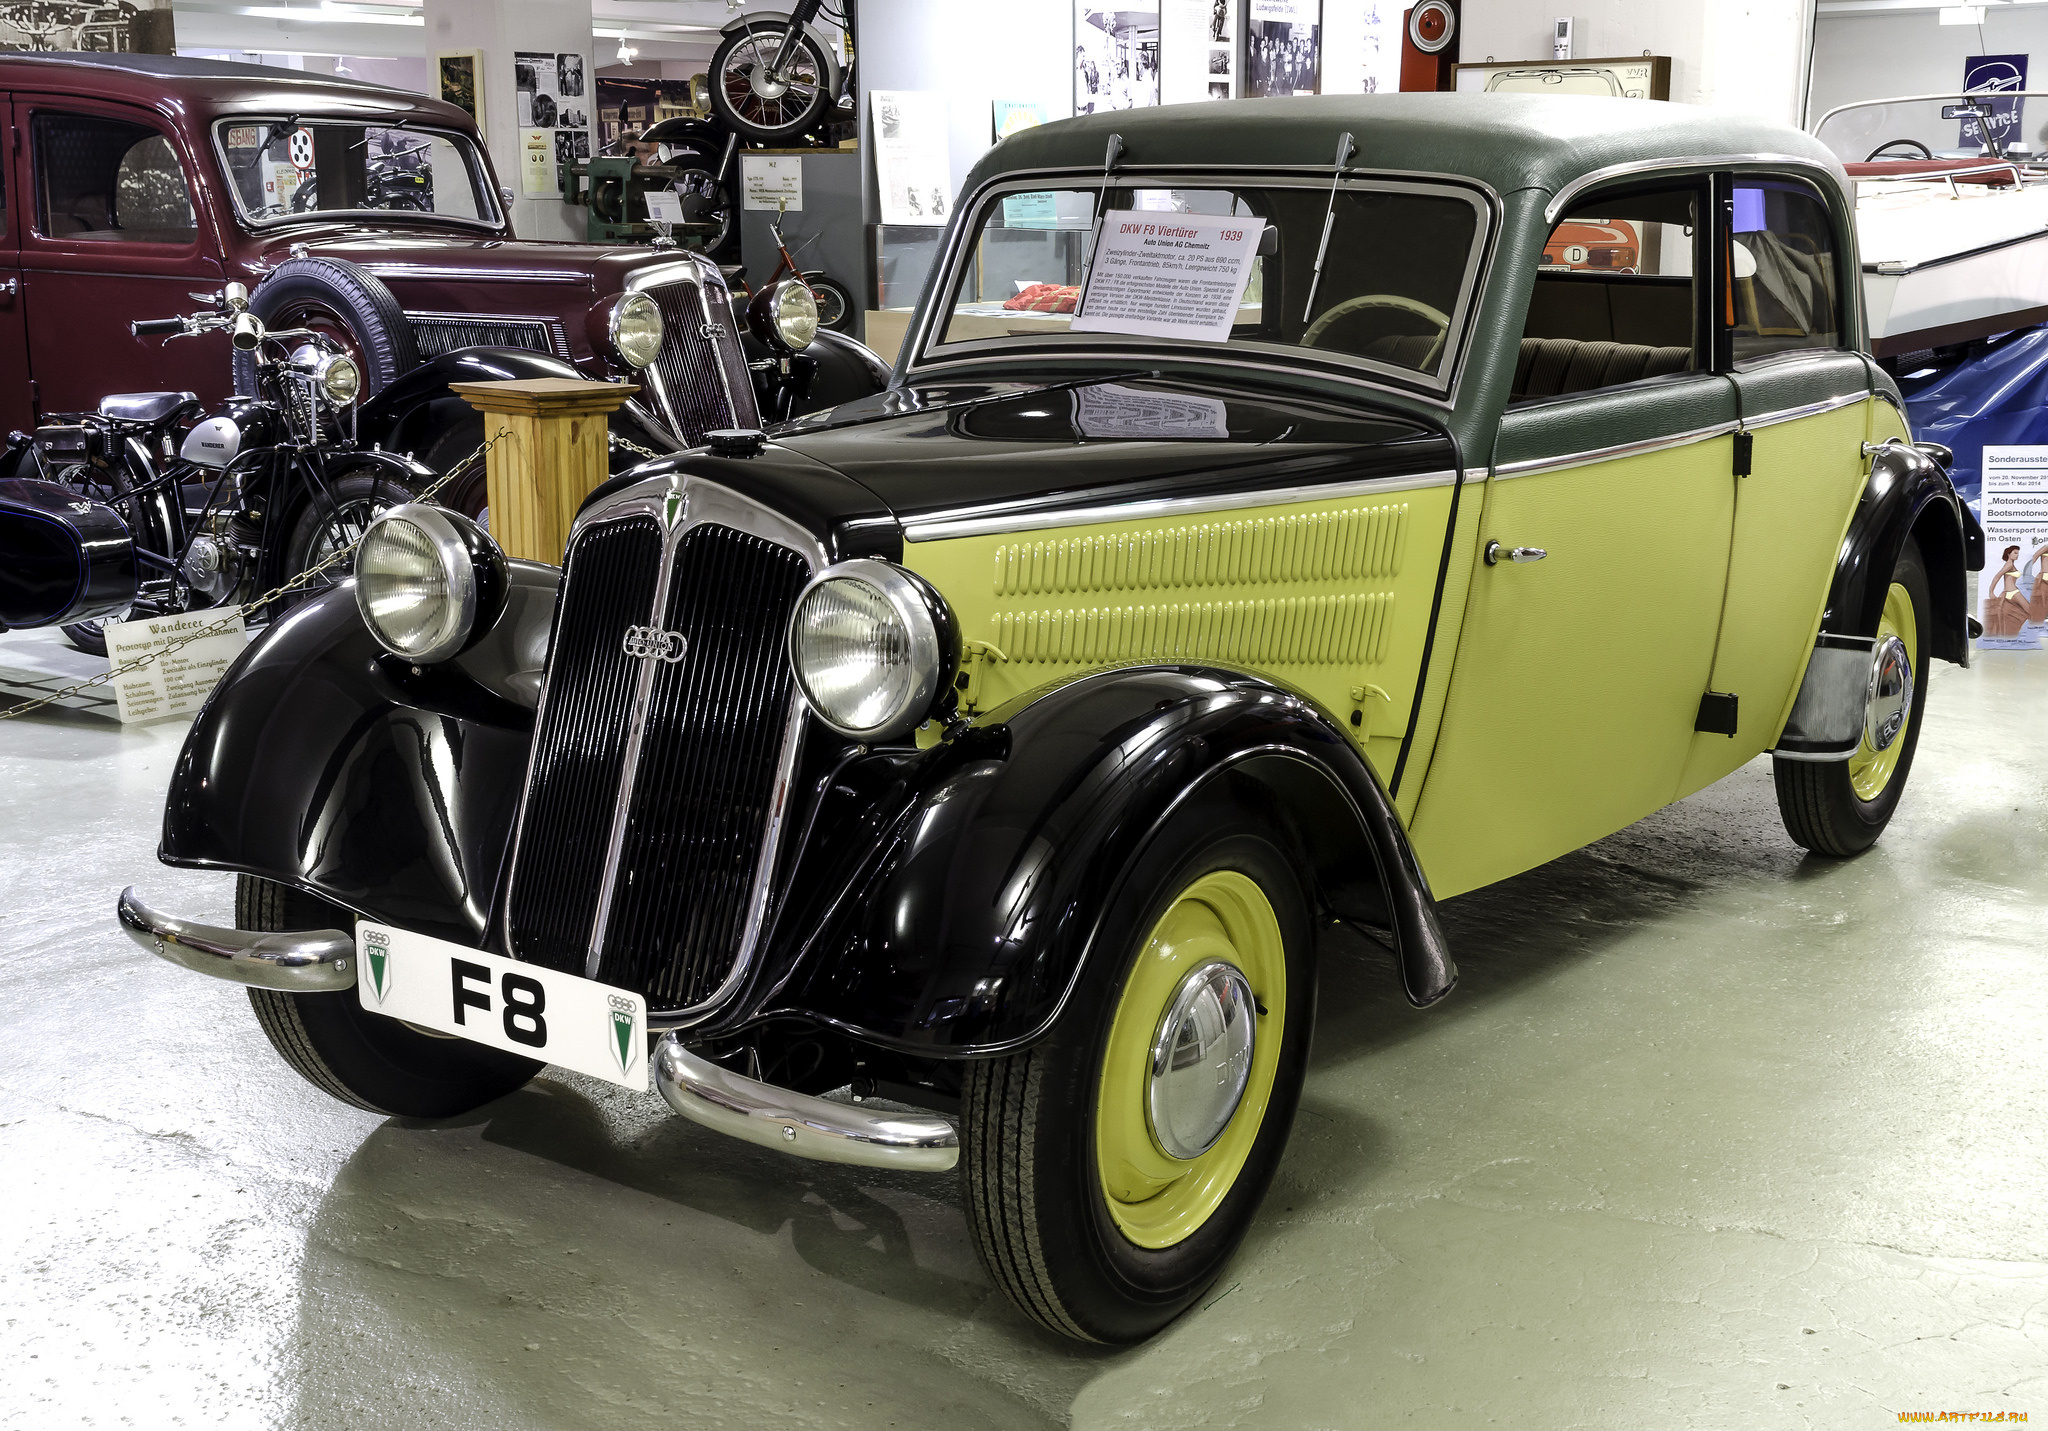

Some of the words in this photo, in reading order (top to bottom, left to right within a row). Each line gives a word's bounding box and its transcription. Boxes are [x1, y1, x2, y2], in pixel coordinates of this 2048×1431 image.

[1119, 223, 1141, 234] DKW
[1142, 225, 1155, 235] F8
[1157, 225, 1198, 238] Viertürer
[1219, 230, 1243, 241] 1939
[1183, 241, 1210, 249] Chemnitz
[1573, 249, 1580, 261] D
[149, 620, 203, 634] Wanderer
[116, 641, 152, 652] Prototyp
[370, 947, 385, 957] DKW
[451, 957, 547, 1048] F8
[615, 1012, 631, 1025] DKW
